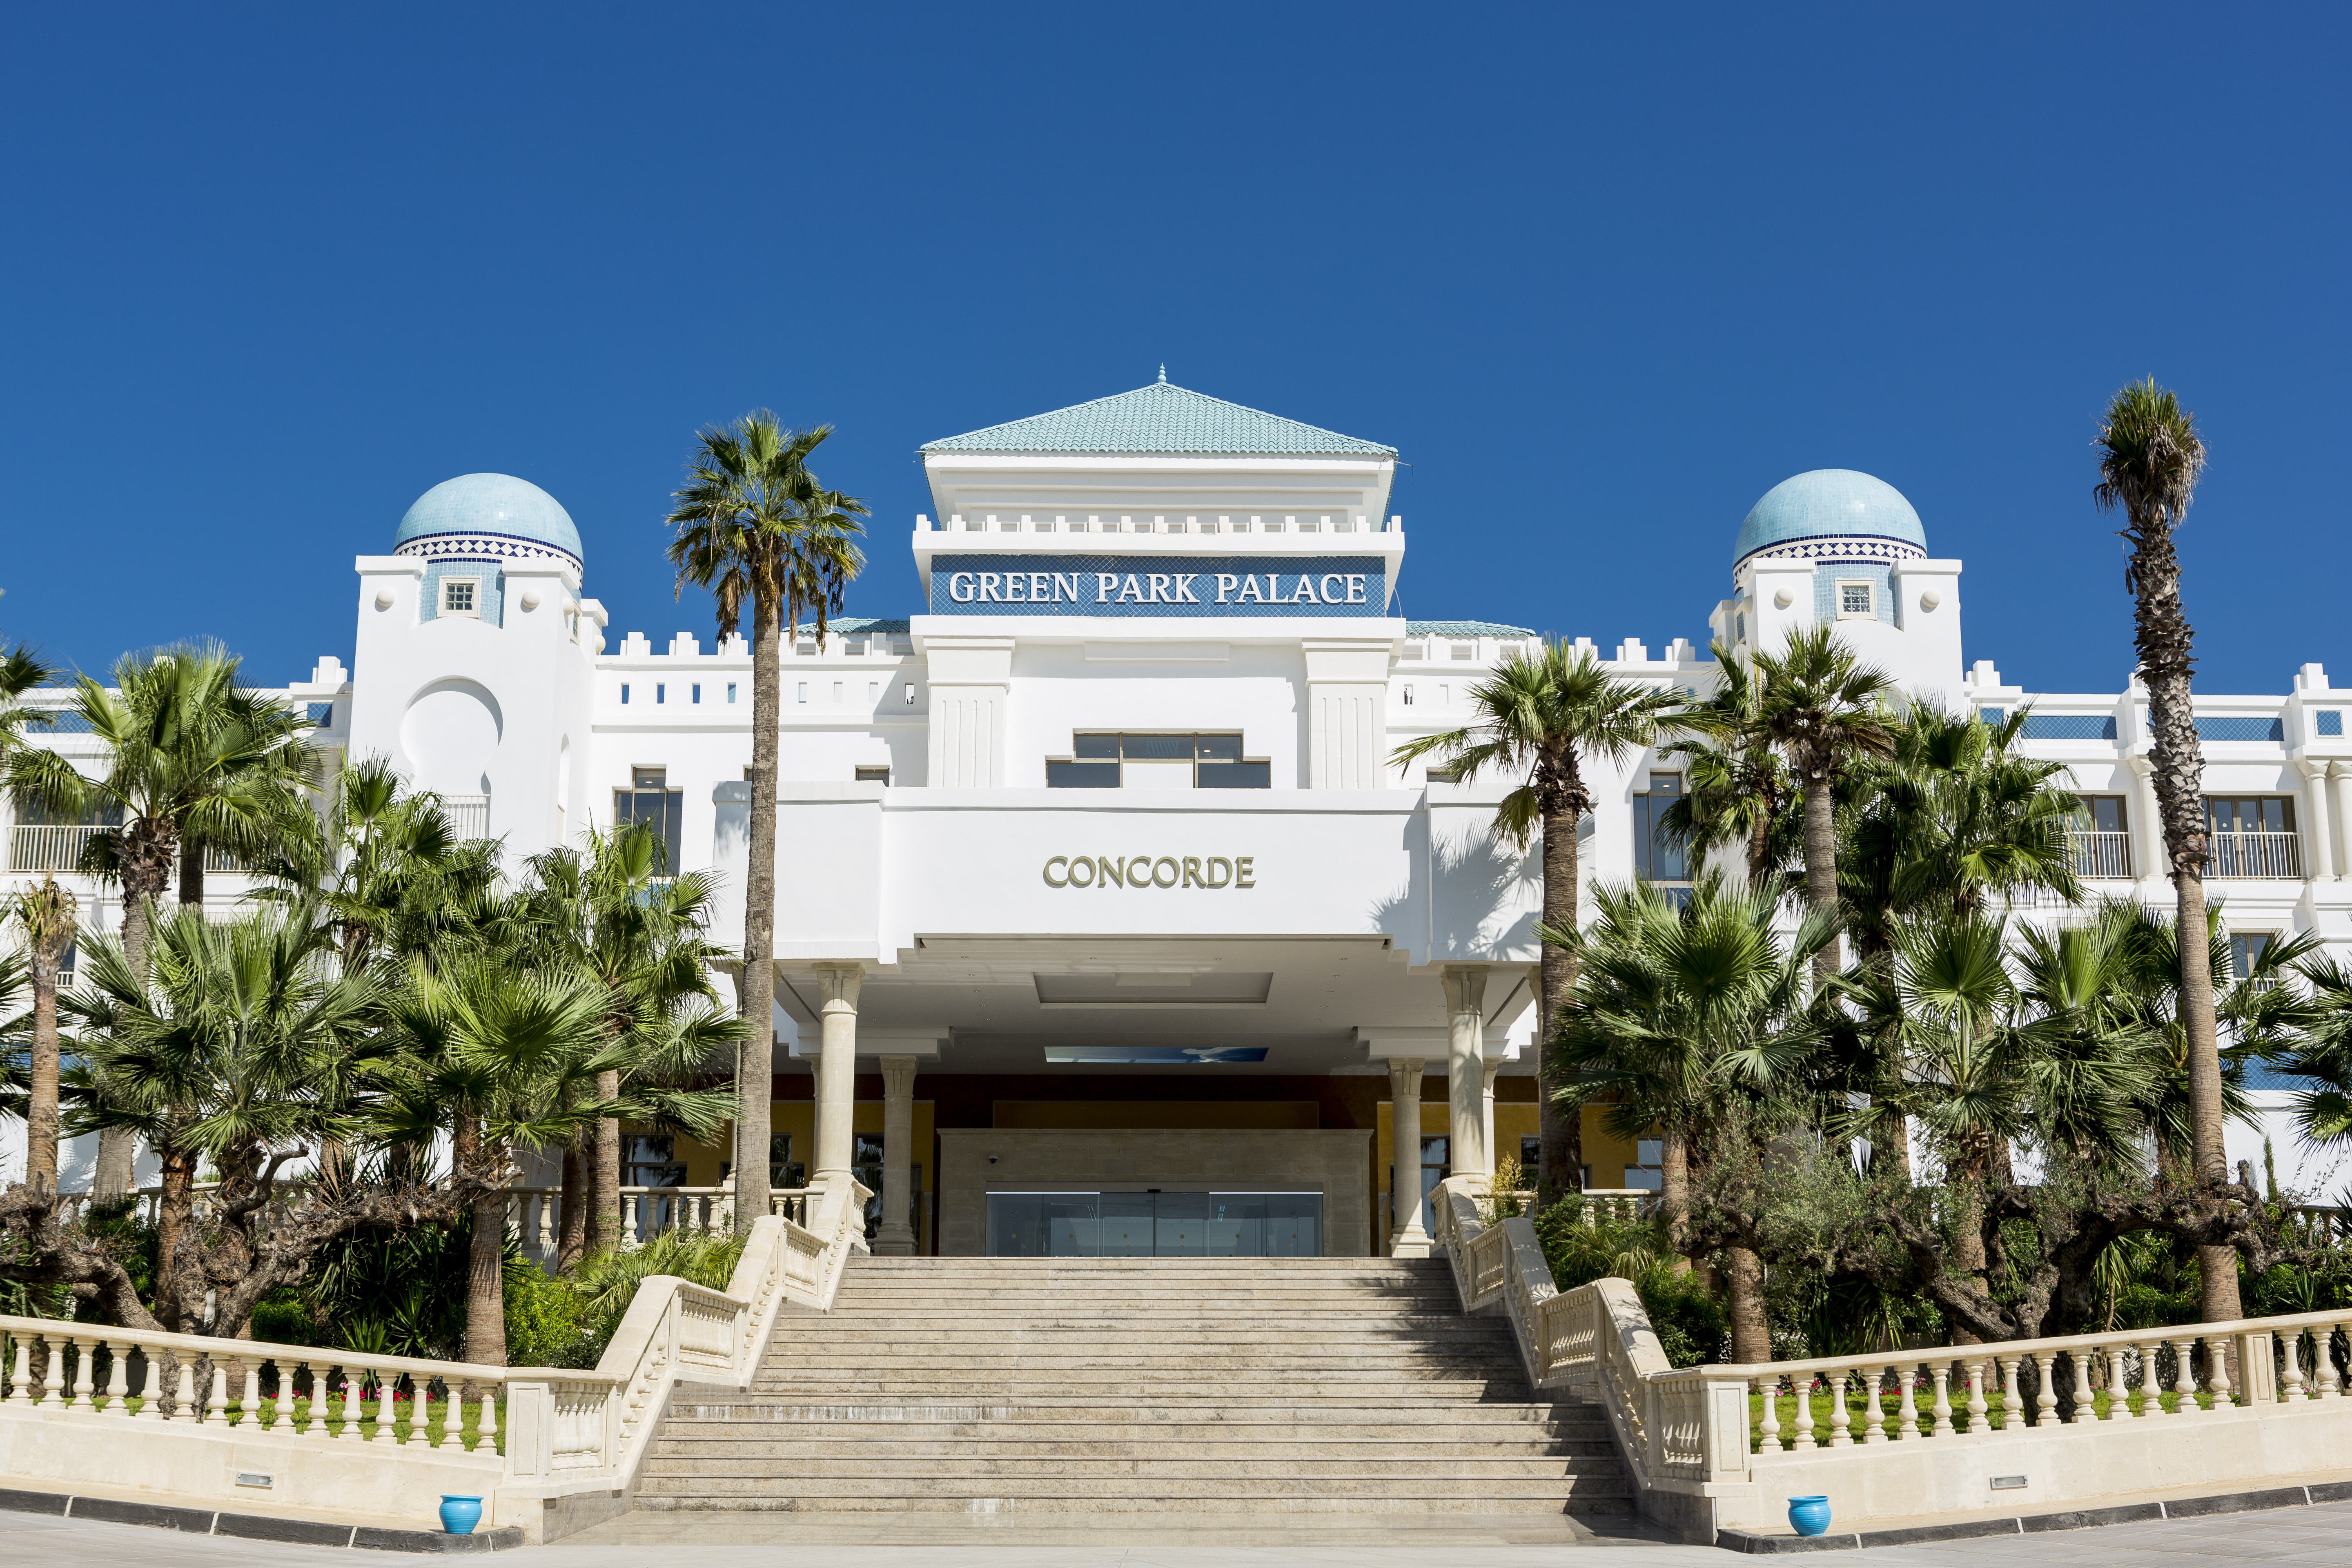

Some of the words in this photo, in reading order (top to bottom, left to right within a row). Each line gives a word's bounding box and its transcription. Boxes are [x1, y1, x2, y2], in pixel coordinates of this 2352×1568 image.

[949, 572, 1080, 602] GREEN
[1095, 573, 1200, 602] PARK
[1214, 574, 1366, 603] PALACE
[1044, 856, 1256, 886] CONCORDE
